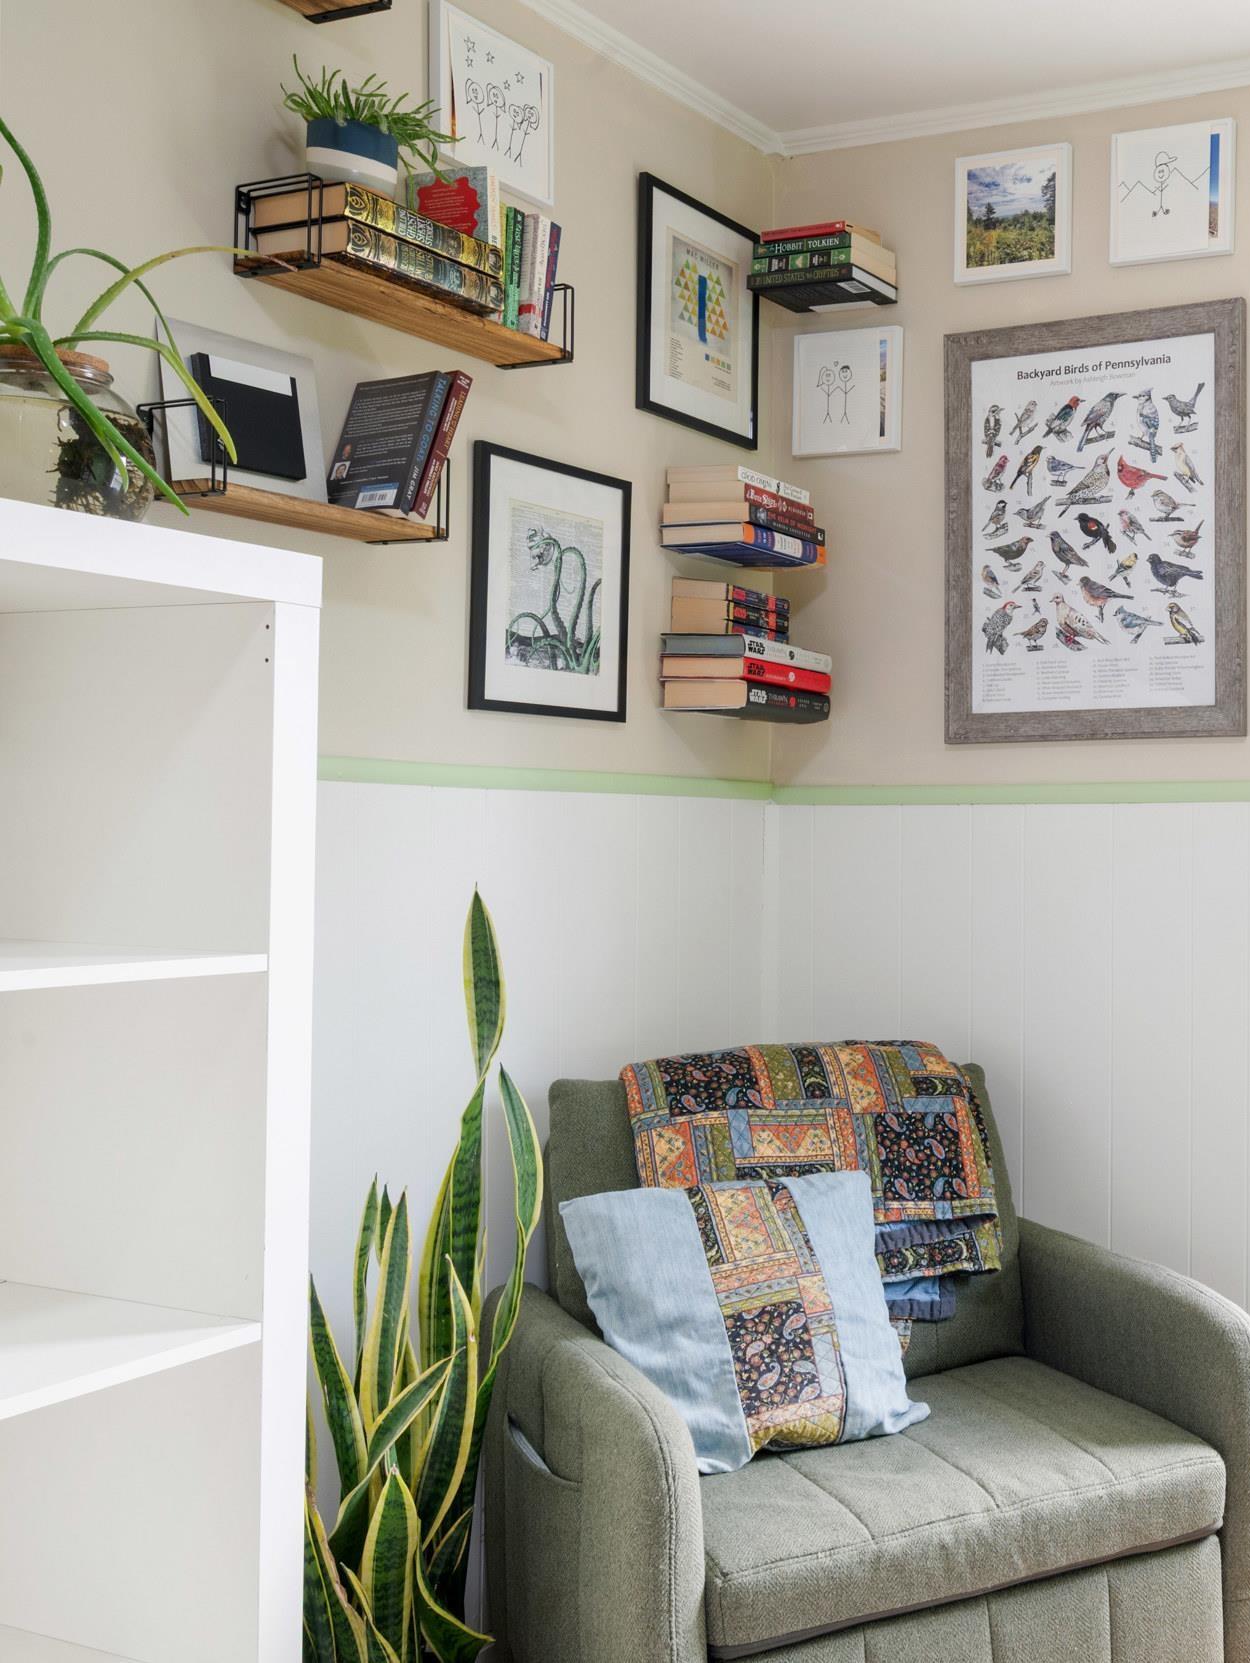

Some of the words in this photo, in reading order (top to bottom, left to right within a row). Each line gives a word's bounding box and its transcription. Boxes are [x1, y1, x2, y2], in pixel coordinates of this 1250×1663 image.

[775, 241, 803, 254] HOBBIT
[808, 237, 840, 249] TOLKIEN
[783, 270, 805, 283] STATES
[1017, 365, 1062, 381] Backyard
[1064, 363, 1089, 376] Birds
[1091, 362, 1103, 372] of
[1105, 354, 1172, 371] Pennsylvania
[1050, 378, 1074, 387] Artwork
[1074, 377, 1082, 386] by
[1083, 373, 1108, 384] Ashleigh
[429, 377, 447, 418] TALKING
[424, 421, 434, 433] TO
[411, 465, 420, 480] JIM
[406, 480, 418, 500] GRAY
[748, 640, 764, 650] STAR
[748, 646, 766, 656] WARS
[747, 662, 765, 672] STAR
[747, 668, 766, 678] WARS
[749, 688, 767, 698] STAR
[749, 694, 768, 705] WARS
